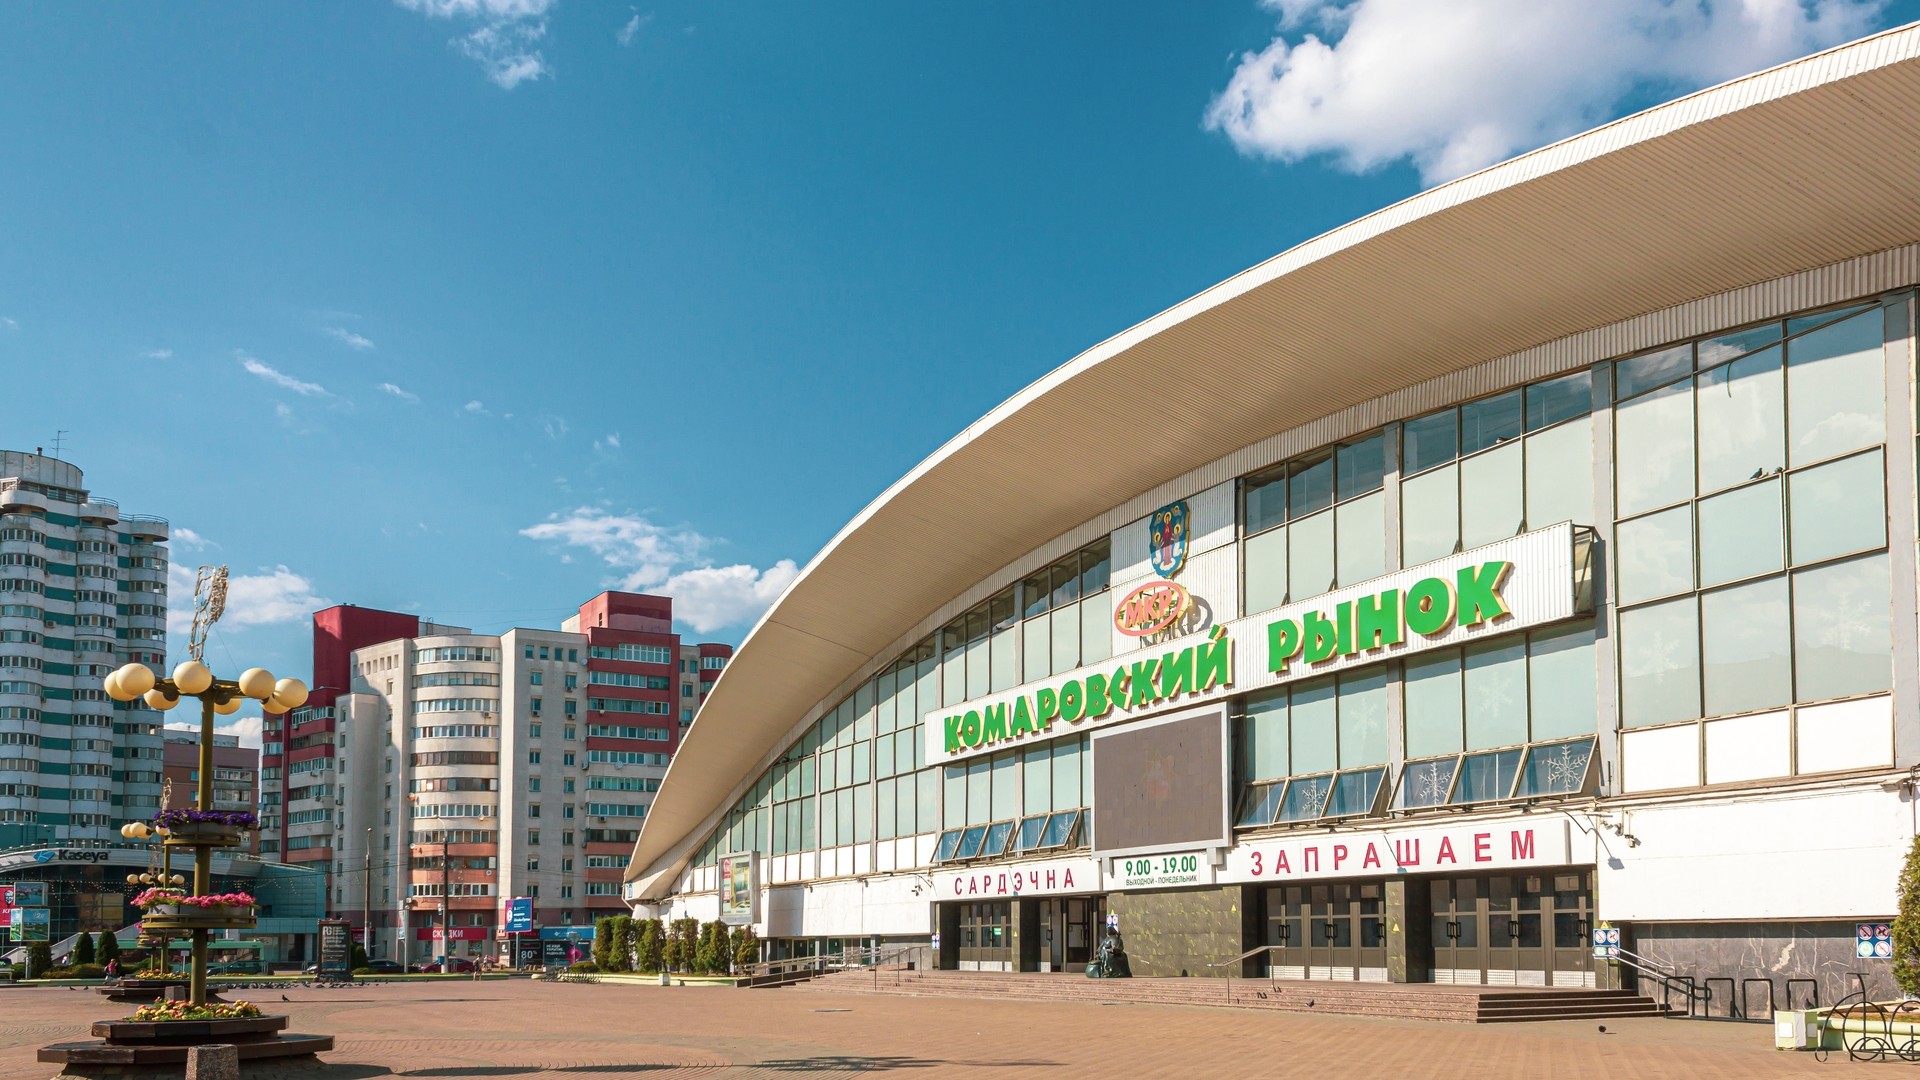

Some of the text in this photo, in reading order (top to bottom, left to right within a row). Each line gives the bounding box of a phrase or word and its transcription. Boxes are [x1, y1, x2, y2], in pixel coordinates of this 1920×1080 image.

[944, 560, 1513, 753] КОМАРОВСКИЙ РЫНОК
[58, 849, 109, 863] Kaseya
[1250, 829, 1535, 877] ЗАПРАШАЕМ
[1125, 859, 1151, 876] 9.00
[1162, 855, 1197, 873] 19.00
[954, 868, 1075, 896] САРДЭЧНА
[1125, 877, 1154, 886] ВЫХОДНОЙ
[1157, 875, 1197, 884] ПОНЕДЕЛЬНИК
[432, 929, 464, 939] СКДКИ
